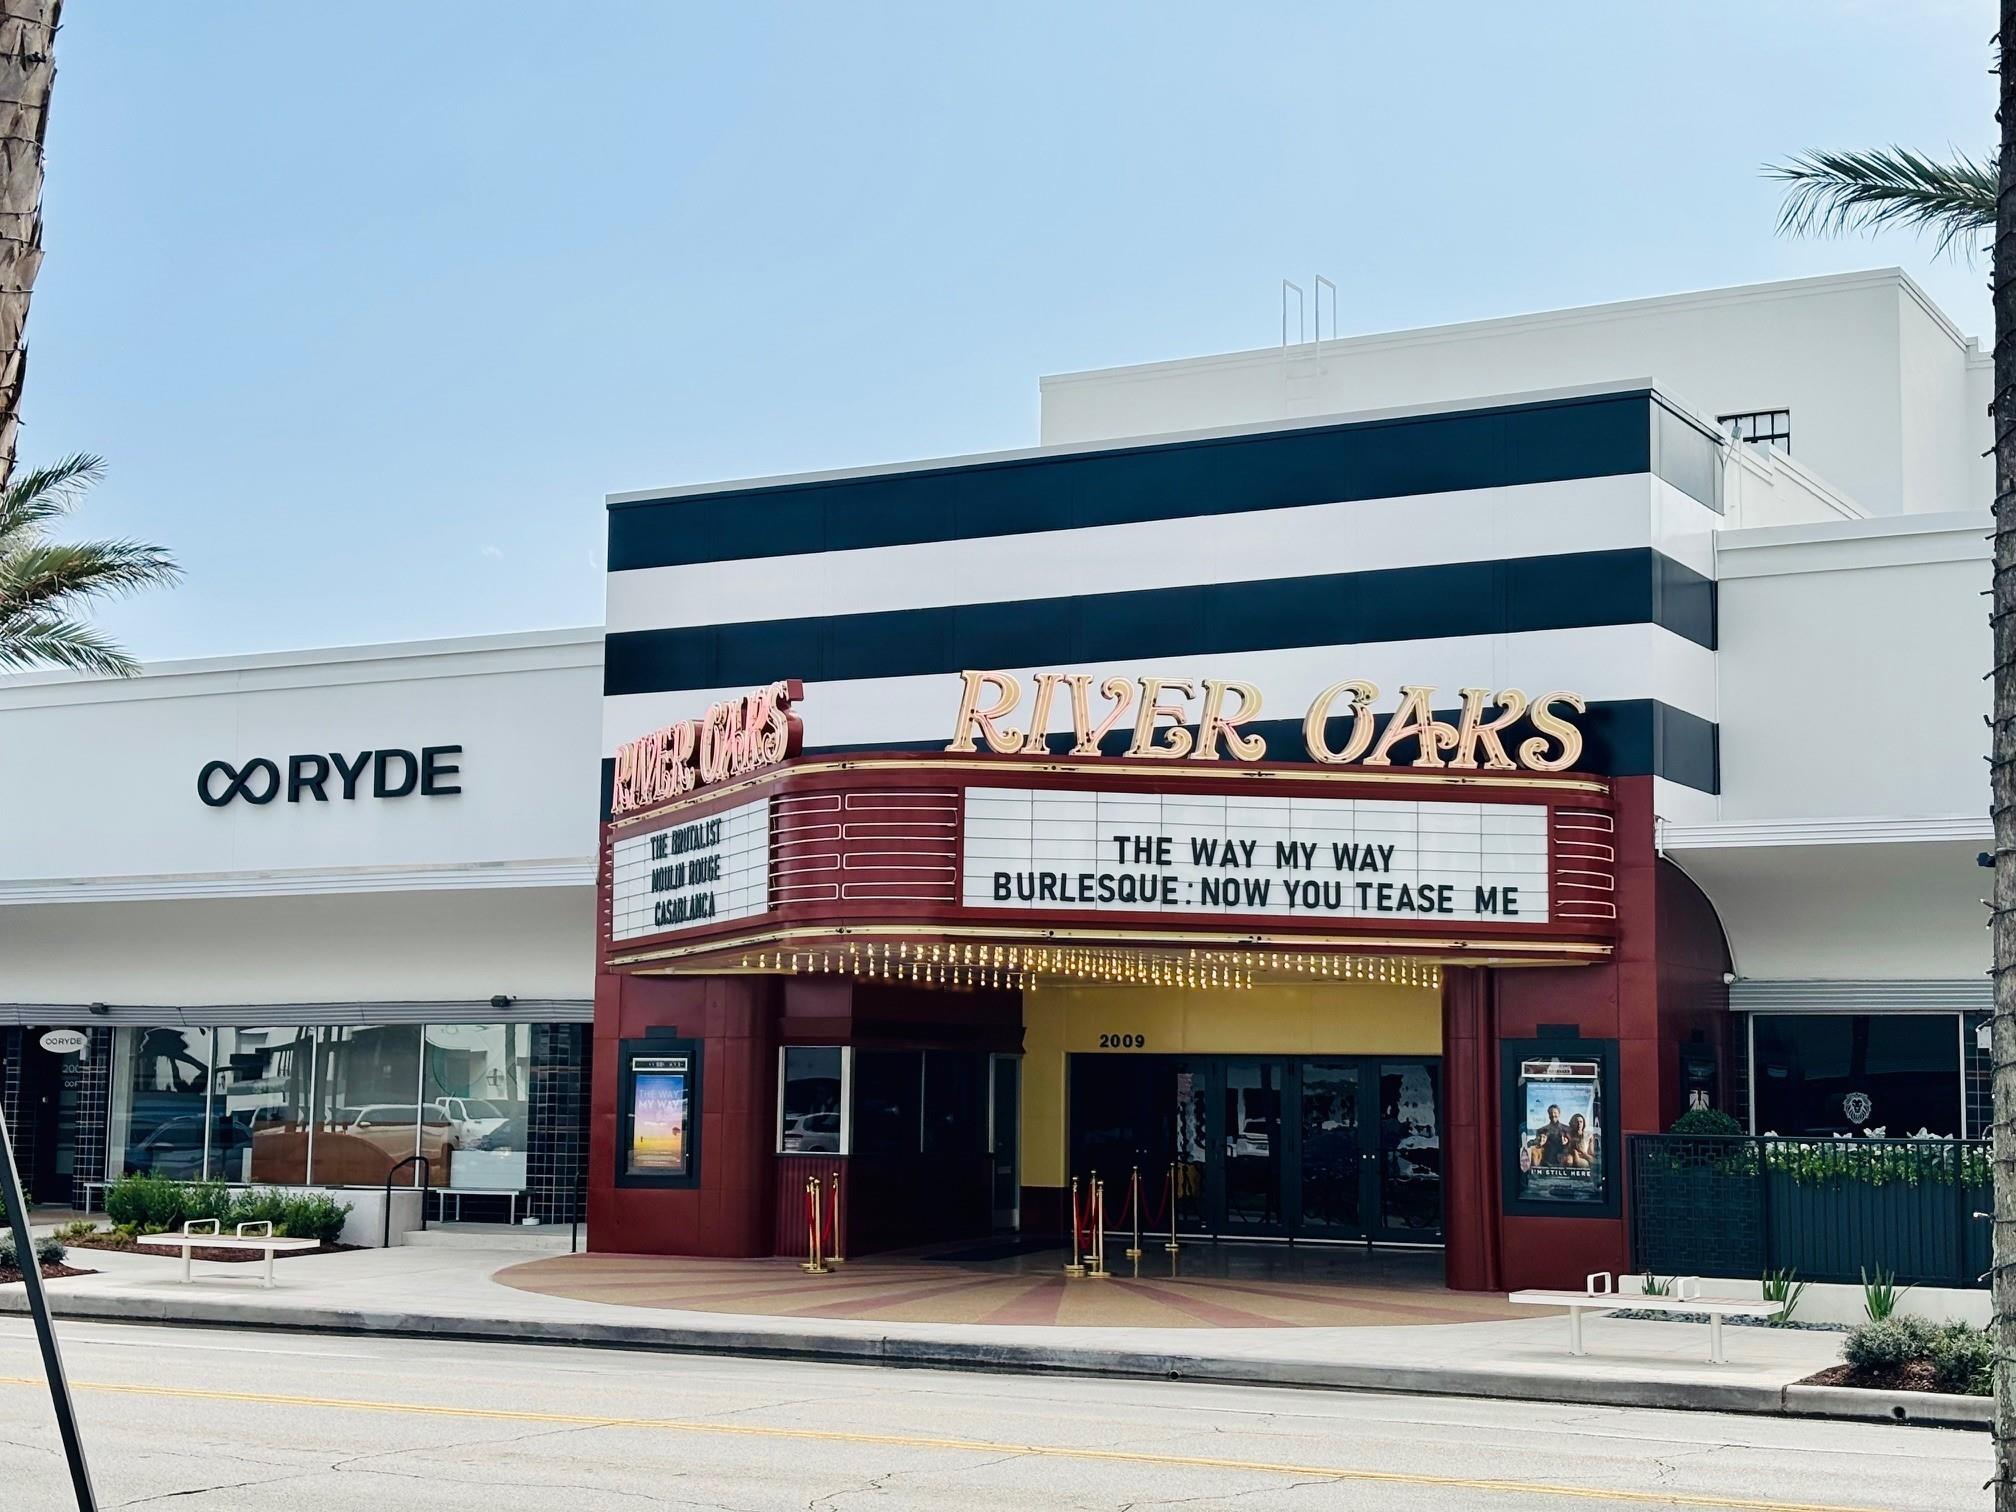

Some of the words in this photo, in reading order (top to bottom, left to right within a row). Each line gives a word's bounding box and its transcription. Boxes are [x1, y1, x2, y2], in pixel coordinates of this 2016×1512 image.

[944, 669, 1267, 762] RIVER
[1302, 678, 1587, 772] OAKS
[611, 720, 696, 814] RIVER
[699, 680, 789, 785] OAKS
[650, 832, 668, 861] THE
[671, 817, 722, 856] BRUTALIST
[1113, 835, 1173, 866] THE
[1191, 837, 1257, 868] WAY
[1275, 840, 1318, 871] MY
[1332, 843, 1395, 873] WAY
[651, 862, 686, 894] MOULIN
[688, 854, 721, 886] ROUGE
[654, 890, 716, 928] CASABLANCA
[1282, 879, 1342, 910] YOU
[1355, 881, 1455, 914] TEASE
[1475, 885, 1519, 916] ME
[1099, 1034, 1145, 1048] 2009
[639, 1100, 655, 1109] MY
[657, 1100, 680, 1110] WAY
[658, 1089, 680, 1099] WAY
